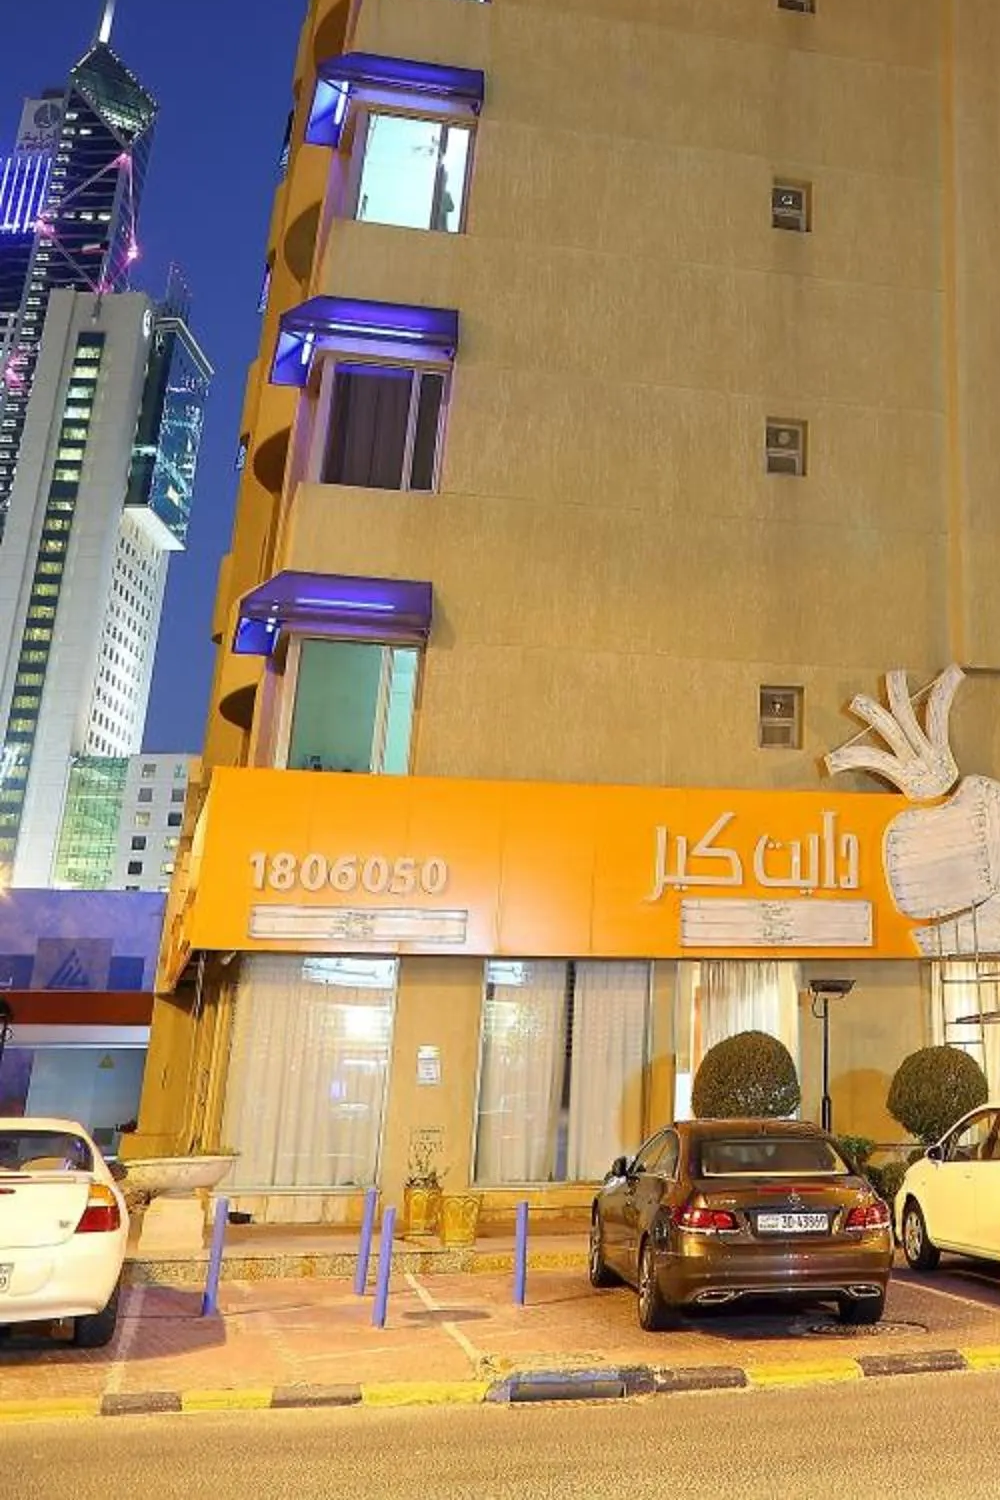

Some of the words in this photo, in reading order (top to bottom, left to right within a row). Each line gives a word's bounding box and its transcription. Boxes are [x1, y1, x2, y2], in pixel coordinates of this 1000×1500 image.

[250, 851, 448, 895] 1806050
[643, 810, 744, 901] كير
[753, 808, 860, 896] دايت
